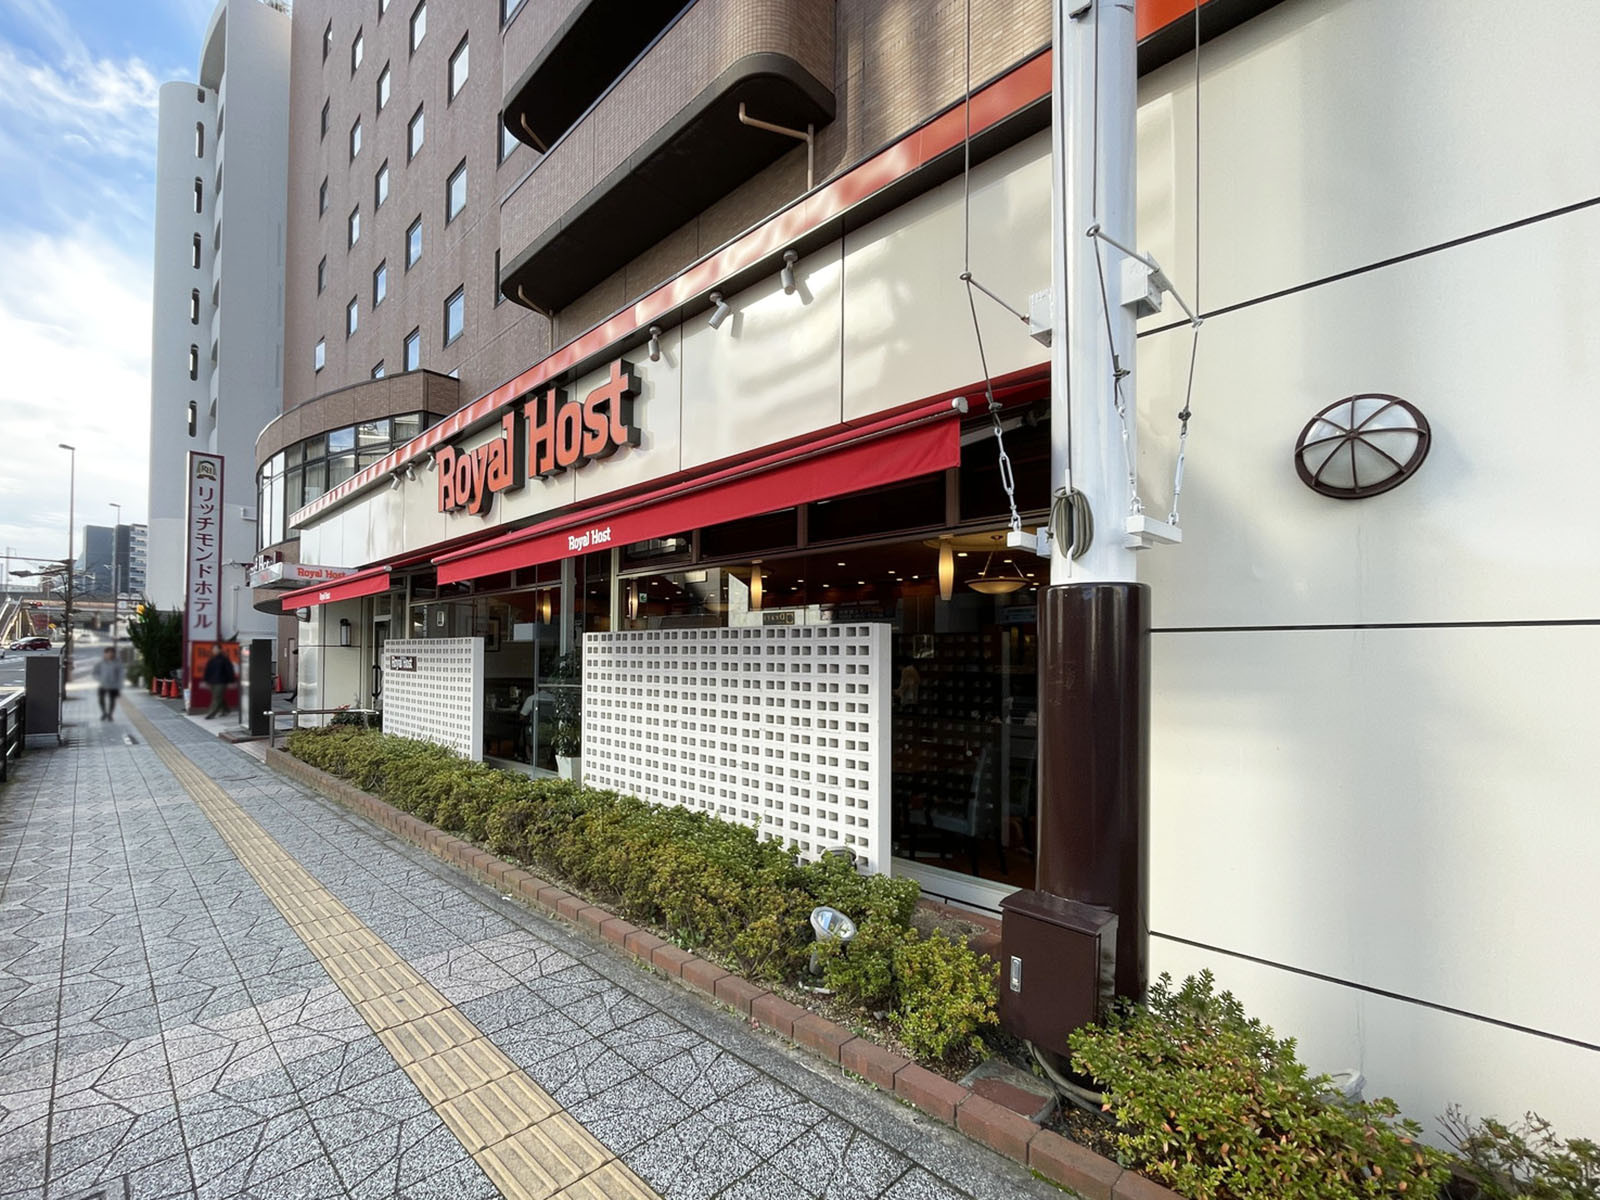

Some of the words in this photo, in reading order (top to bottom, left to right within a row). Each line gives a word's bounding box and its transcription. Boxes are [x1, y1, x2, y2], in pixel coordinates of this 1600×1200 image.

[436, 410, 515, 515] Royal
[524, 357, 629, 479] Host
[193, 486, 215, 629] リッチモンドホテル
[297, 567, 323, 579] Royal
[325, 569, 346, 579] Host
[568, 531, 590, 551] Royal
[591, 526, 611, 545] Host
